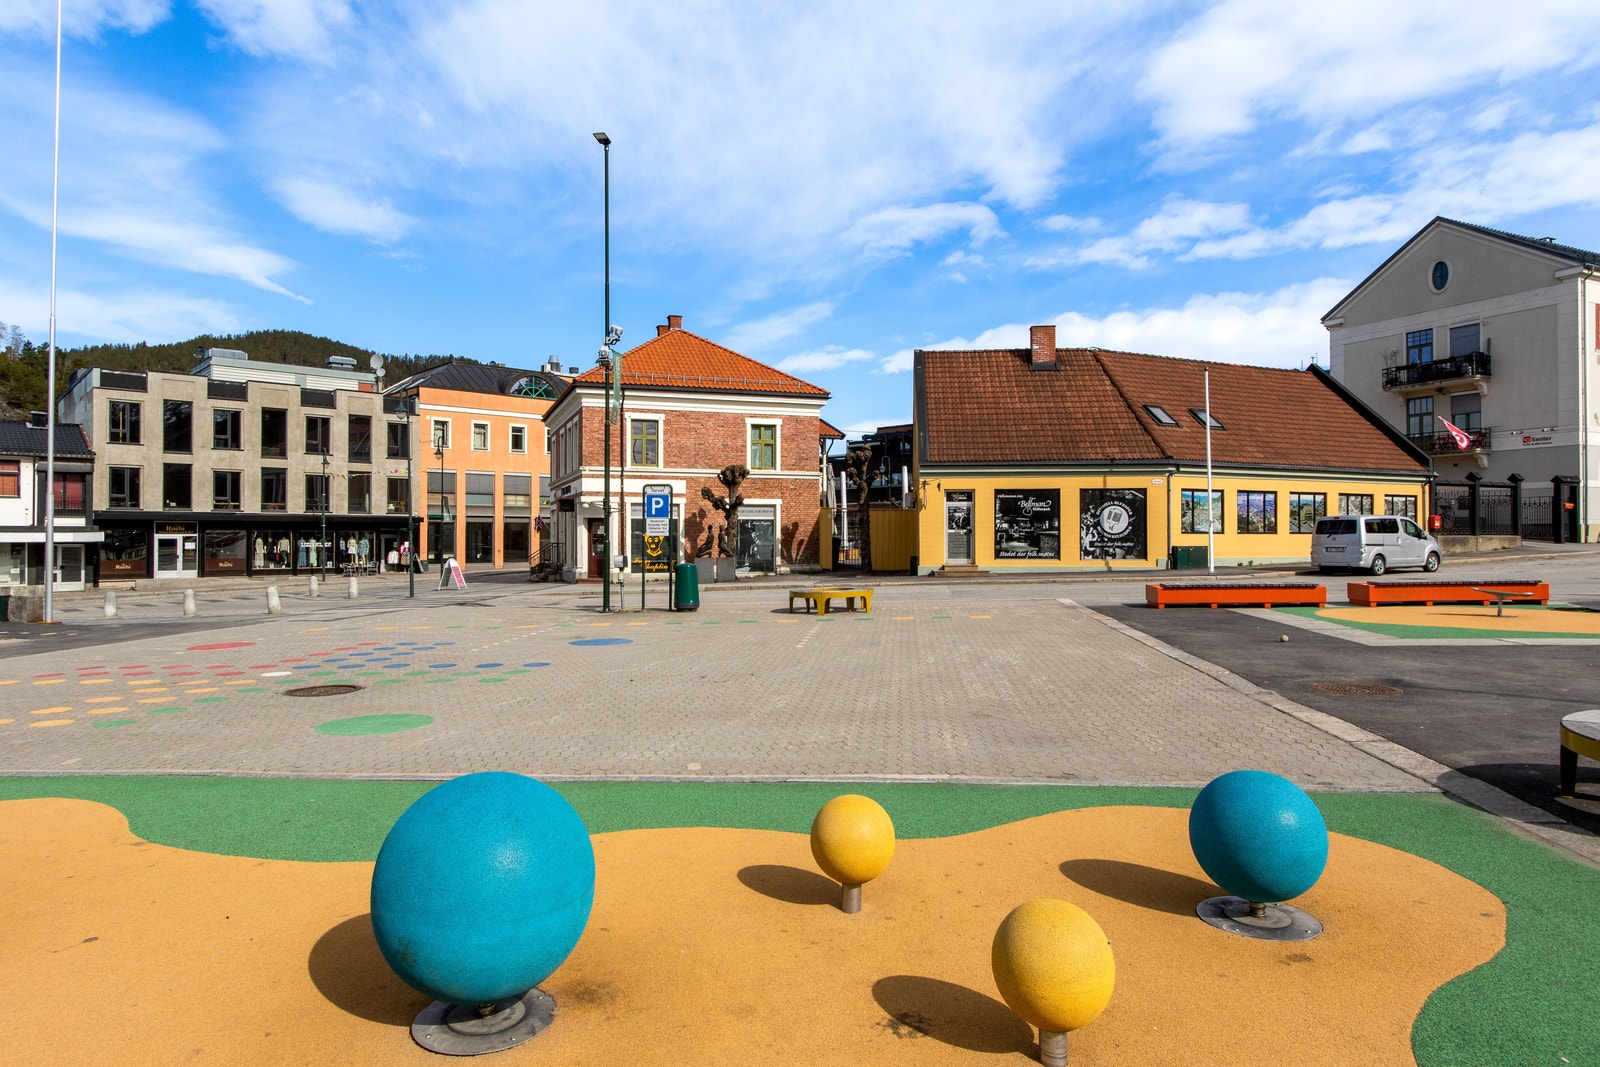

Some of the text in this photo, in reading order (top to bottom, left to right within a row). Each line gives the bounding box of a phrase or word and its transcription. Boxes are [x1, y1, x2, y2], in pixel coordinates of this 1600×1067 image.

[651, 497, 664, 515] P
[1018, 497, 1052, 516] Bellman
[1025, 551, 1038, 559] folk
